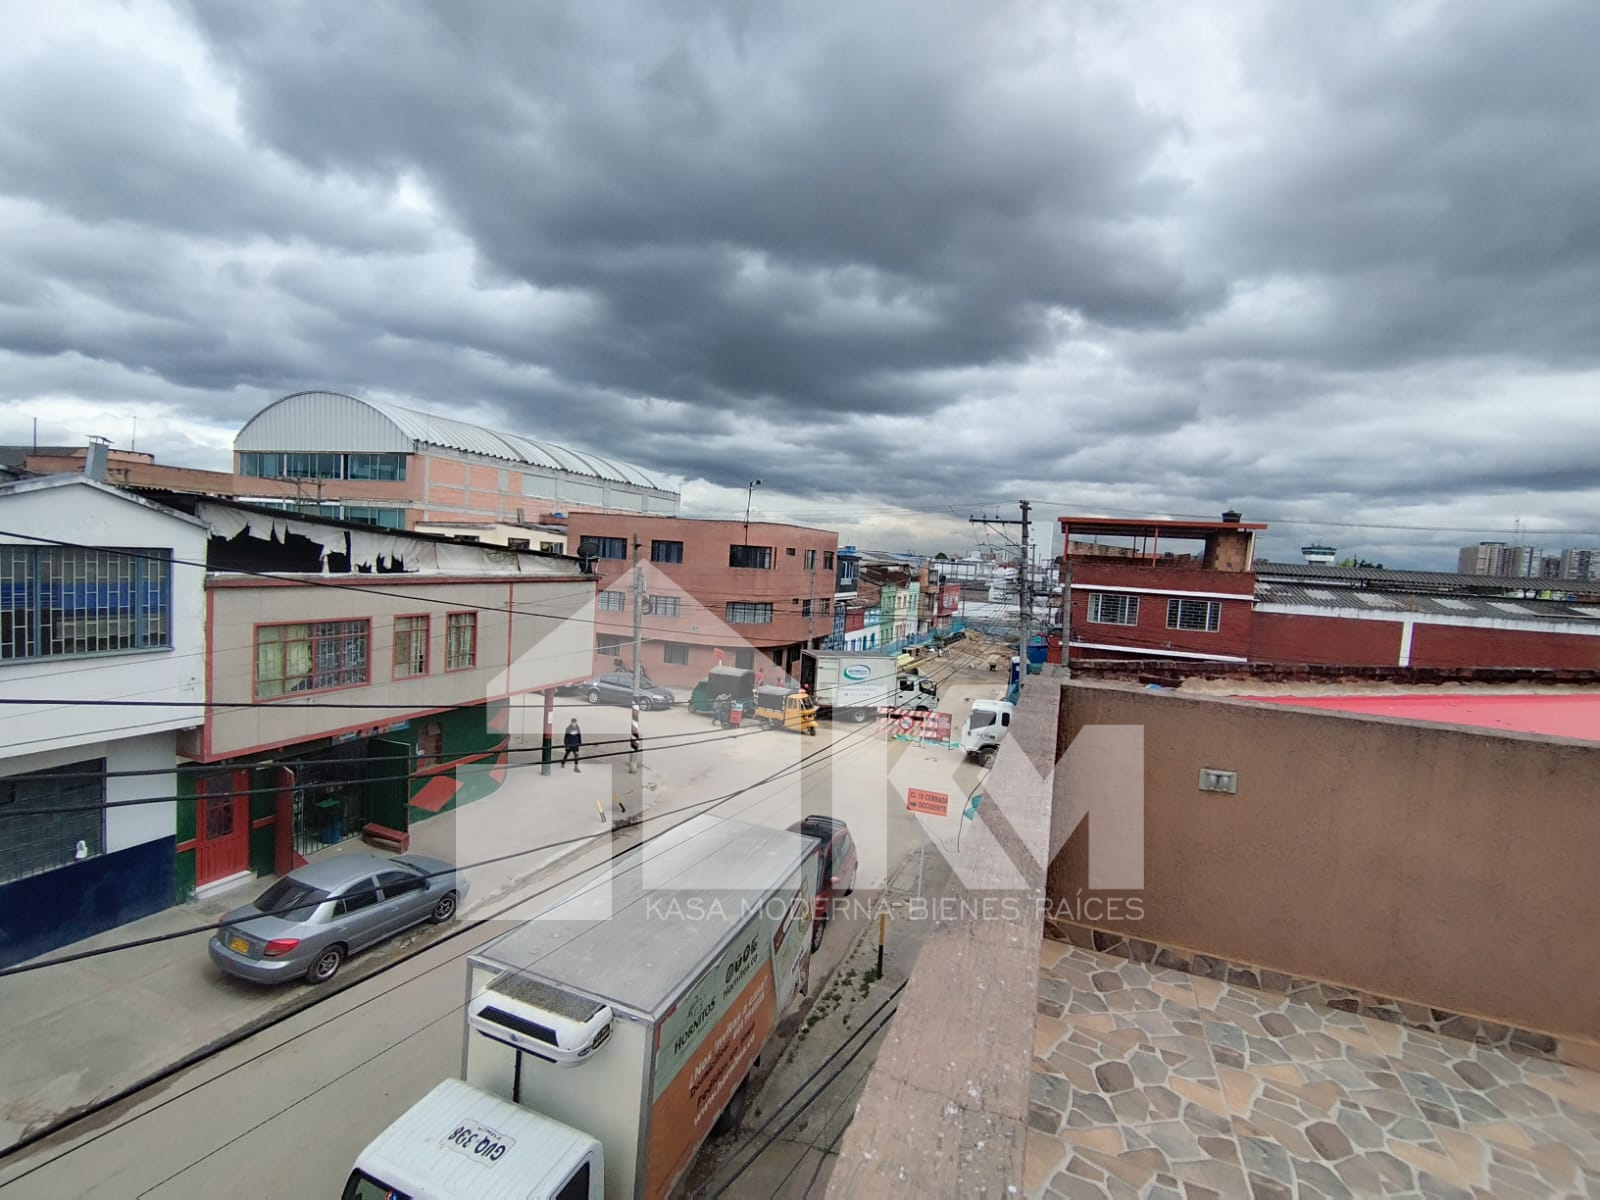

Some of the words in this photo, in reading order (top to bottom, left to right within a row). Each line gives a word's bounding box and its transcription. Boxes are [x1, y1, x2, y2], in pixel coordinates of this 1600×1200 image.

[918, 801, 947, 813] OCCIDENTE
[674, 996, 716, 1055] HORNITOS
[447, 1126, 479, 1149] 398
[474, 1135, 506, 1162] GUQ
